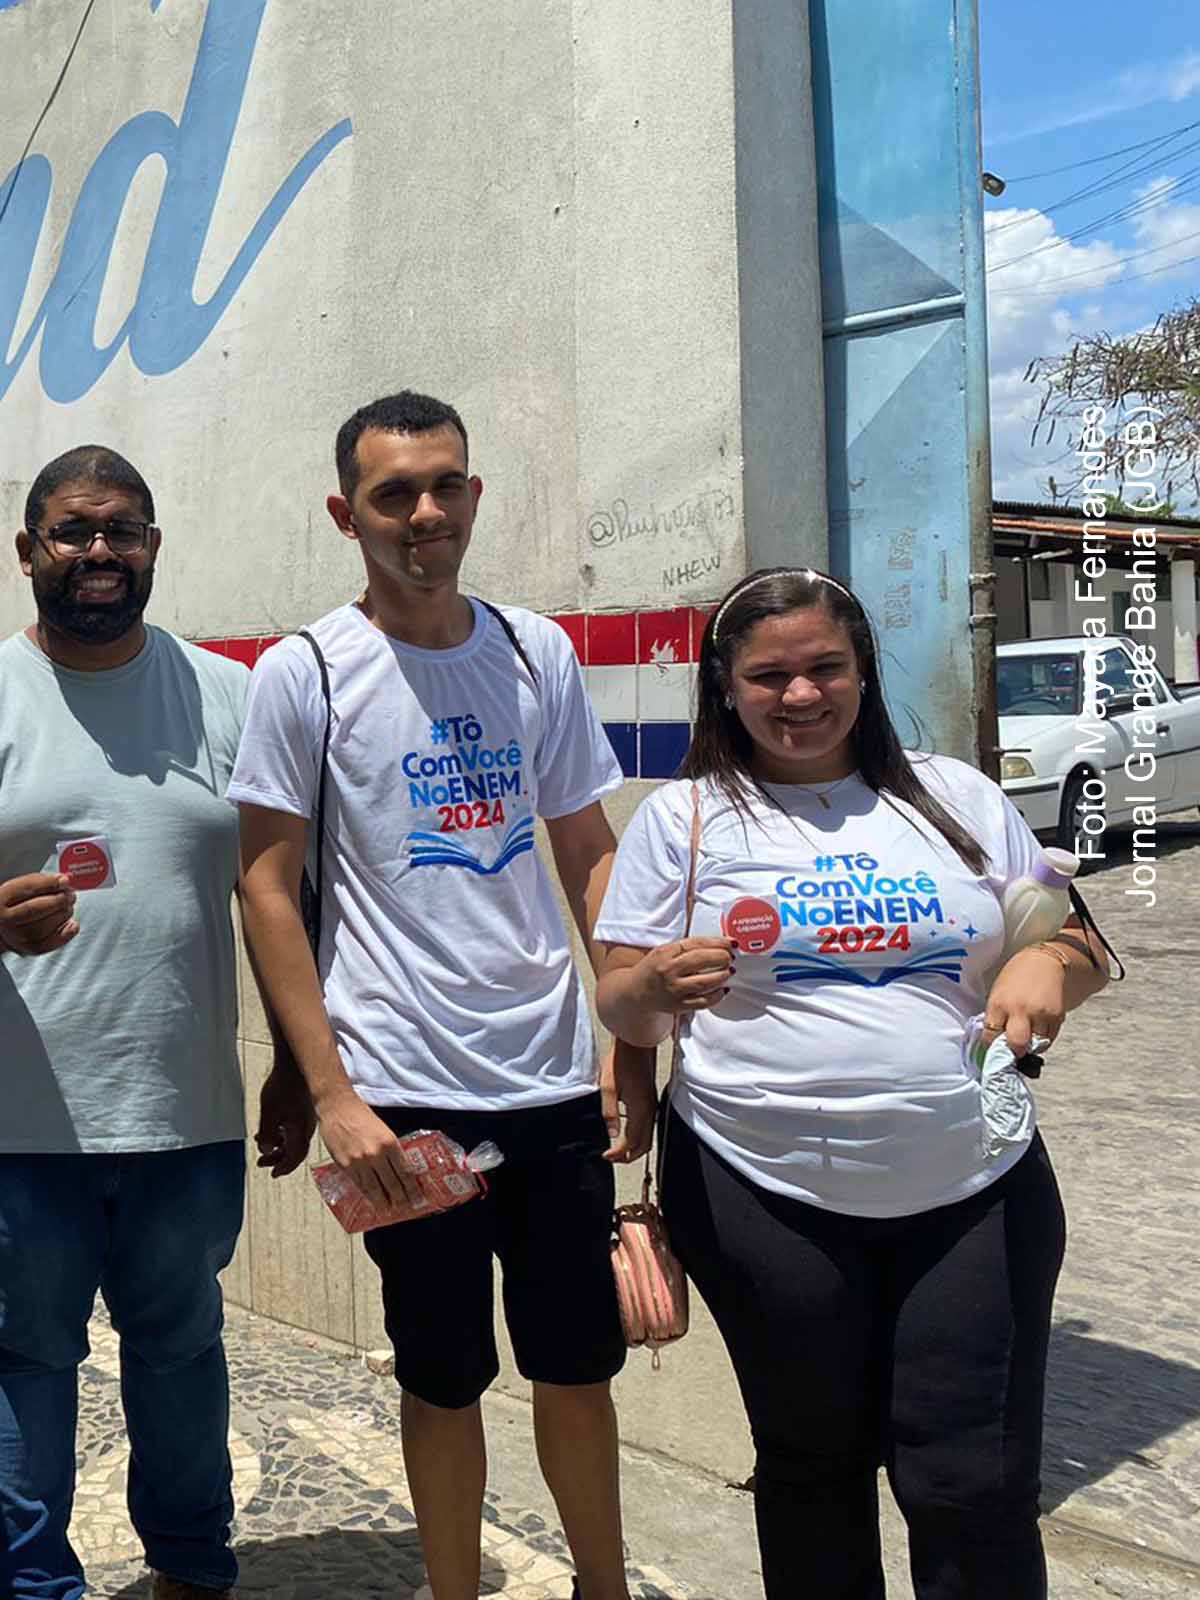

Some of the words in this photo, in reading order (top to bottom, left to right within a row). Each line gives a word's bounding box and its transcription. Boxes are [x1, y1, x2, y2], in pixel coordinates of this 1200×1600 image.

[431, 713, 483, 745] #Tô
[402, 739, 523, 779] ComVocê
[408, 770, 521, 808] NoENEM
[437, 800, 506, 833] 2024
[815, 852, 879, 873] #Tô
[776, 870, 938, 899] ComVocê
[780, 896, 944, 927] NoENEM
[816, 925, 912, 954] 2024
